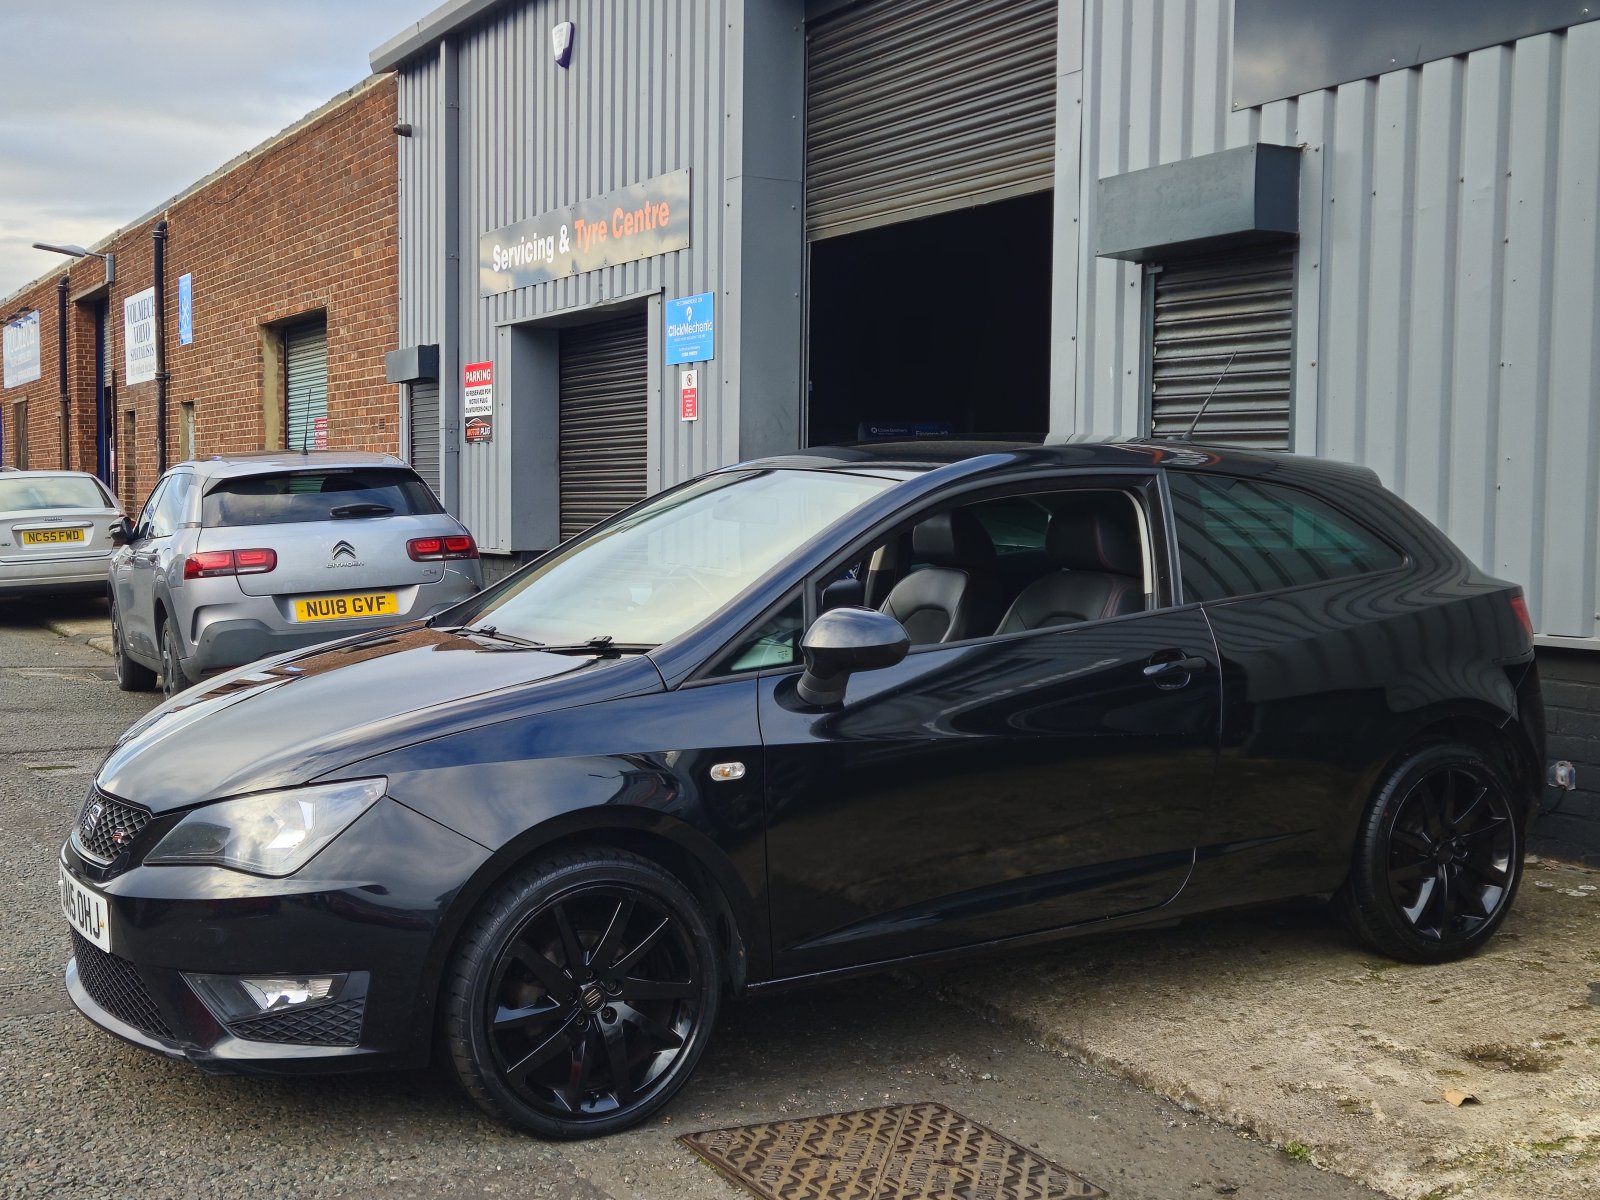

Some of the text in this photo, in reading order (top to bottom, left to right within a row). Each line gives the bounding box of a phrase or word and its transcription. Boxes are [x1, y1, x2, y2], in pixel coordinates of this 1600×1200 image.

[492, 200, 670, 273] Servicing & Tyre Centre
[133, 322, 151, 345] VOLVO
[668, 321, 712, 336] ClickMechanic
[466, 369, 490, 383] PARKING
[28, 530, 79, 542] NC55 FWD
[306, 595, 386, 618] NU18 GVF
[77, 889, 101, 940] OHJ
